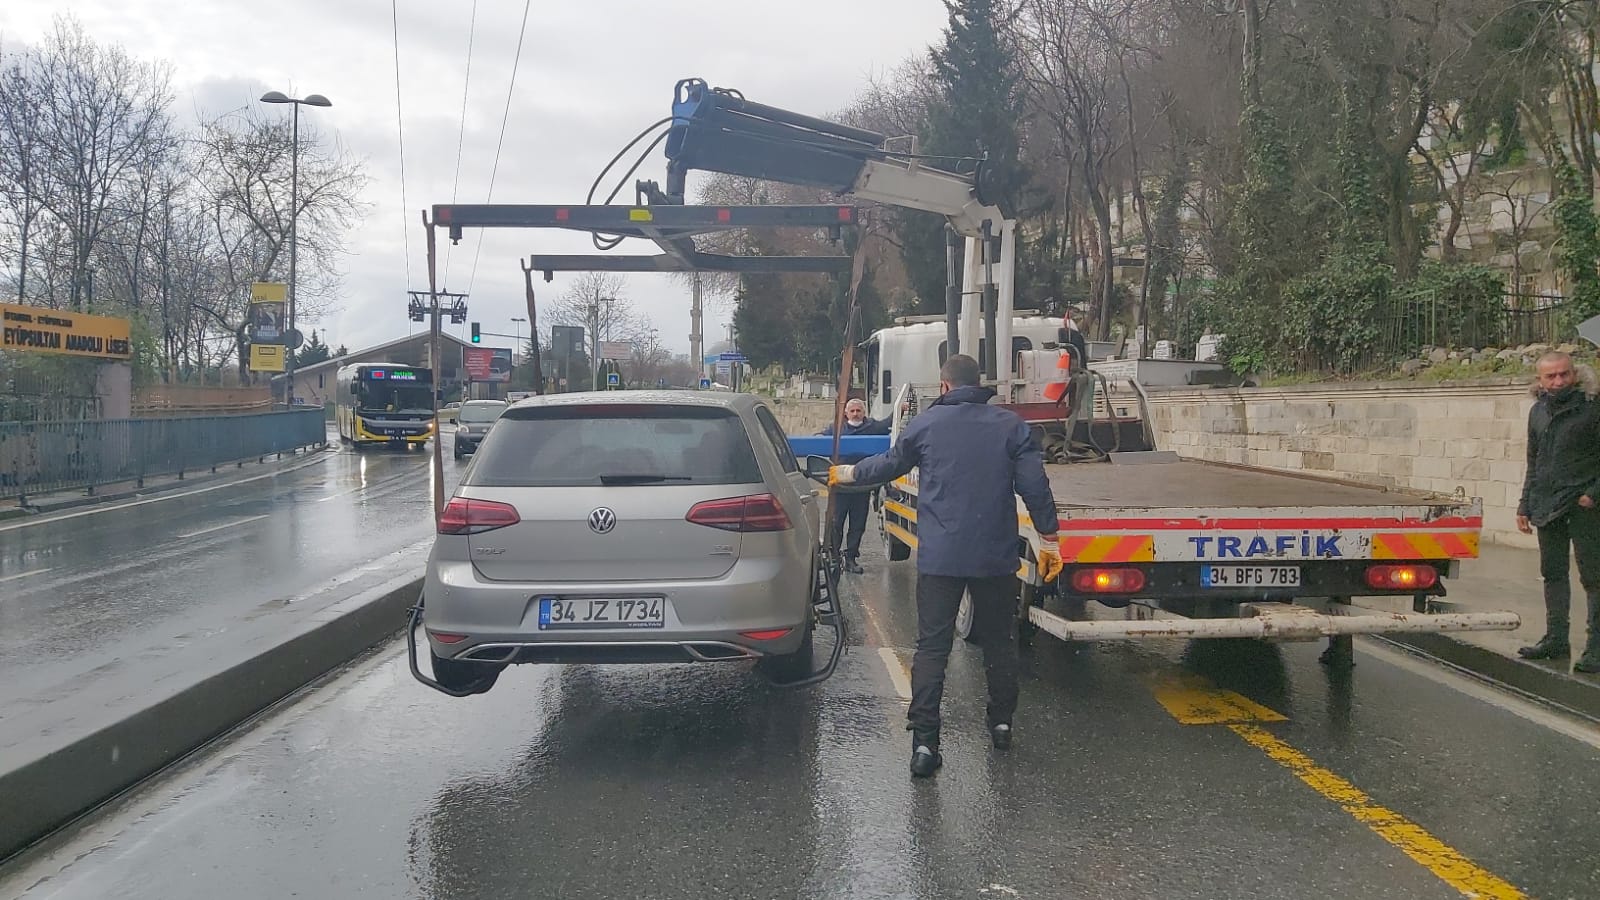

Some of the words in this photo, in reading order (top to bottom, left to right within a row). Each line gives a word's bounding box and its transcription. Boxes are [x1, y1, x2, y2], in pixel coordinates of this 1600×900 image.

[4, 325, 60, 348] EYÜPSULTAN
[65, 334, 102, 352] ANADOLU
[1188, 530, 1343, 557] TRAFİK
[1211, 568, 1228, 584] 34
[1235, 568, 1262, 584] BFG
[1270, 568, 1297, 584] 783
[551, 601, 575, 621] 34
[583, 601, 608, 620] JZ
[616, 600, 660, 620] 1734
